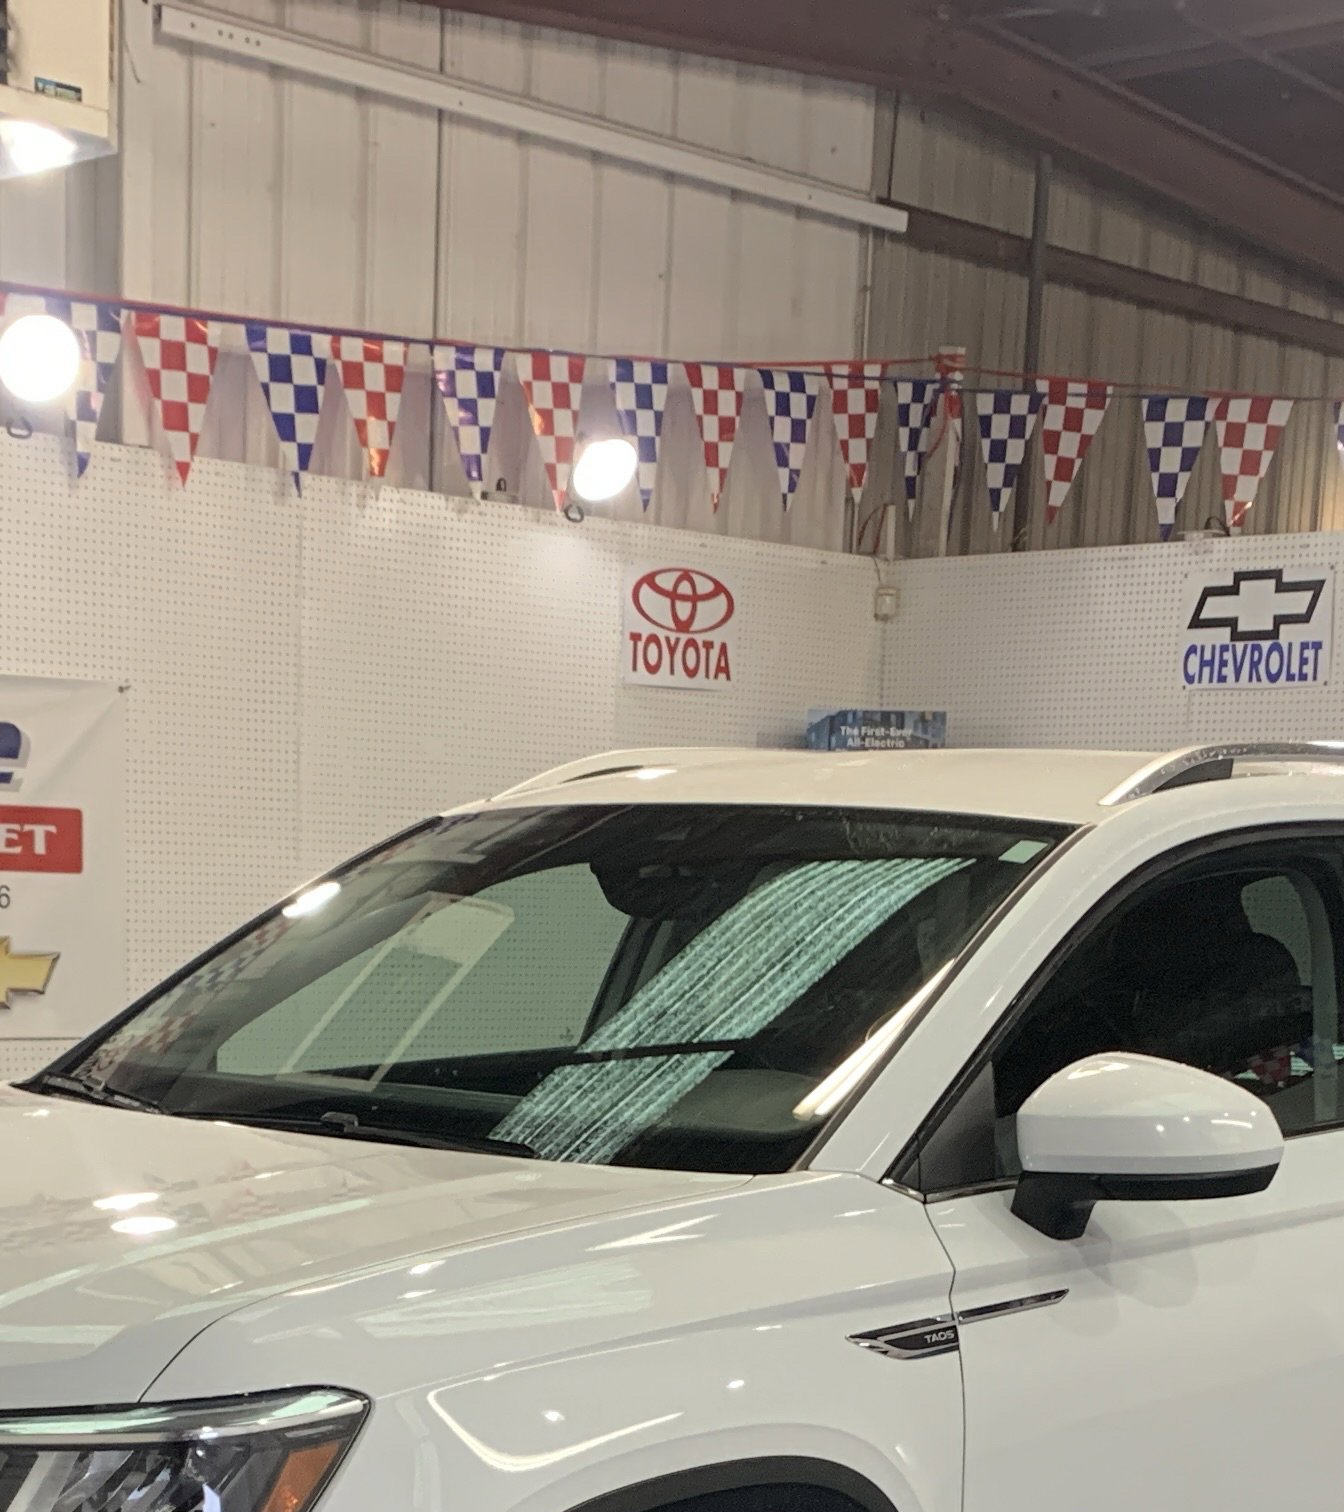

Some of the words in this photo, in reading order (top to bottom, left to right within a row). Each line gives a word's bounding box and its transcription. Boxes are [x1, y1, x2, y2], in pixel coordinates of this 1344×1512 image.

[629, 631, 731, 681] TOYOTA
[1183, 641, 1323, 685] CHEVROLET
[924, 1330, 955, 1344] TAOS
